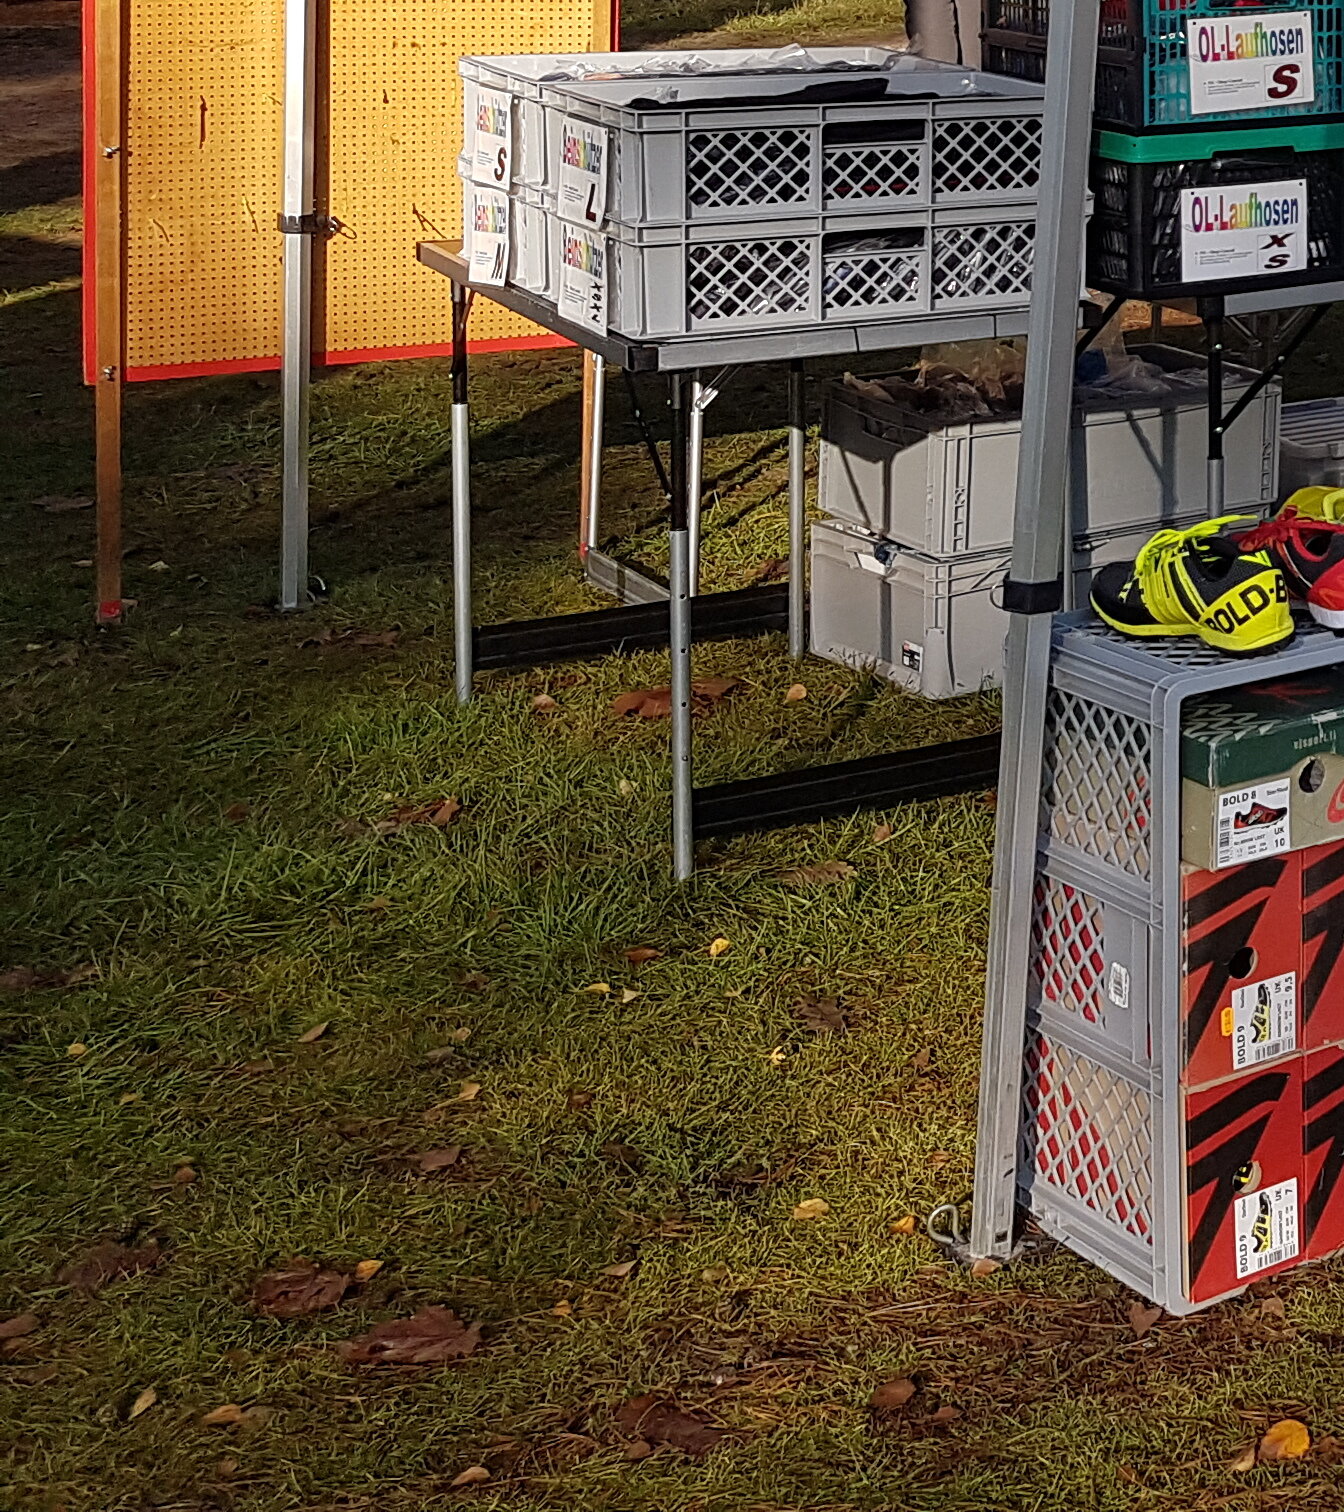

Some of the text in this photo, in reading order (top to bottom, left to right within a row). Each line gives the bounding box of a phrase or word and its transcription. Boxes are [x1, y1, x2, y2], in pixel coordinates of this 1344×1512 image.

[1200, 21, 1304, 63] OL-Laufhosen
[1267, 63, 1301, 100] S
[493, 146, 508, 182] S
[585, 183, 597, 223] L
[1191, 192, 1299, 233] OL-Laufhosen
[1222, 792, 1249, 807] BOLD
[1274, 837, 1286, 848] 10
[1237, 1035, 1246, 1064] BOLD
[1239, 1244, 1248, 1273] BOLD
